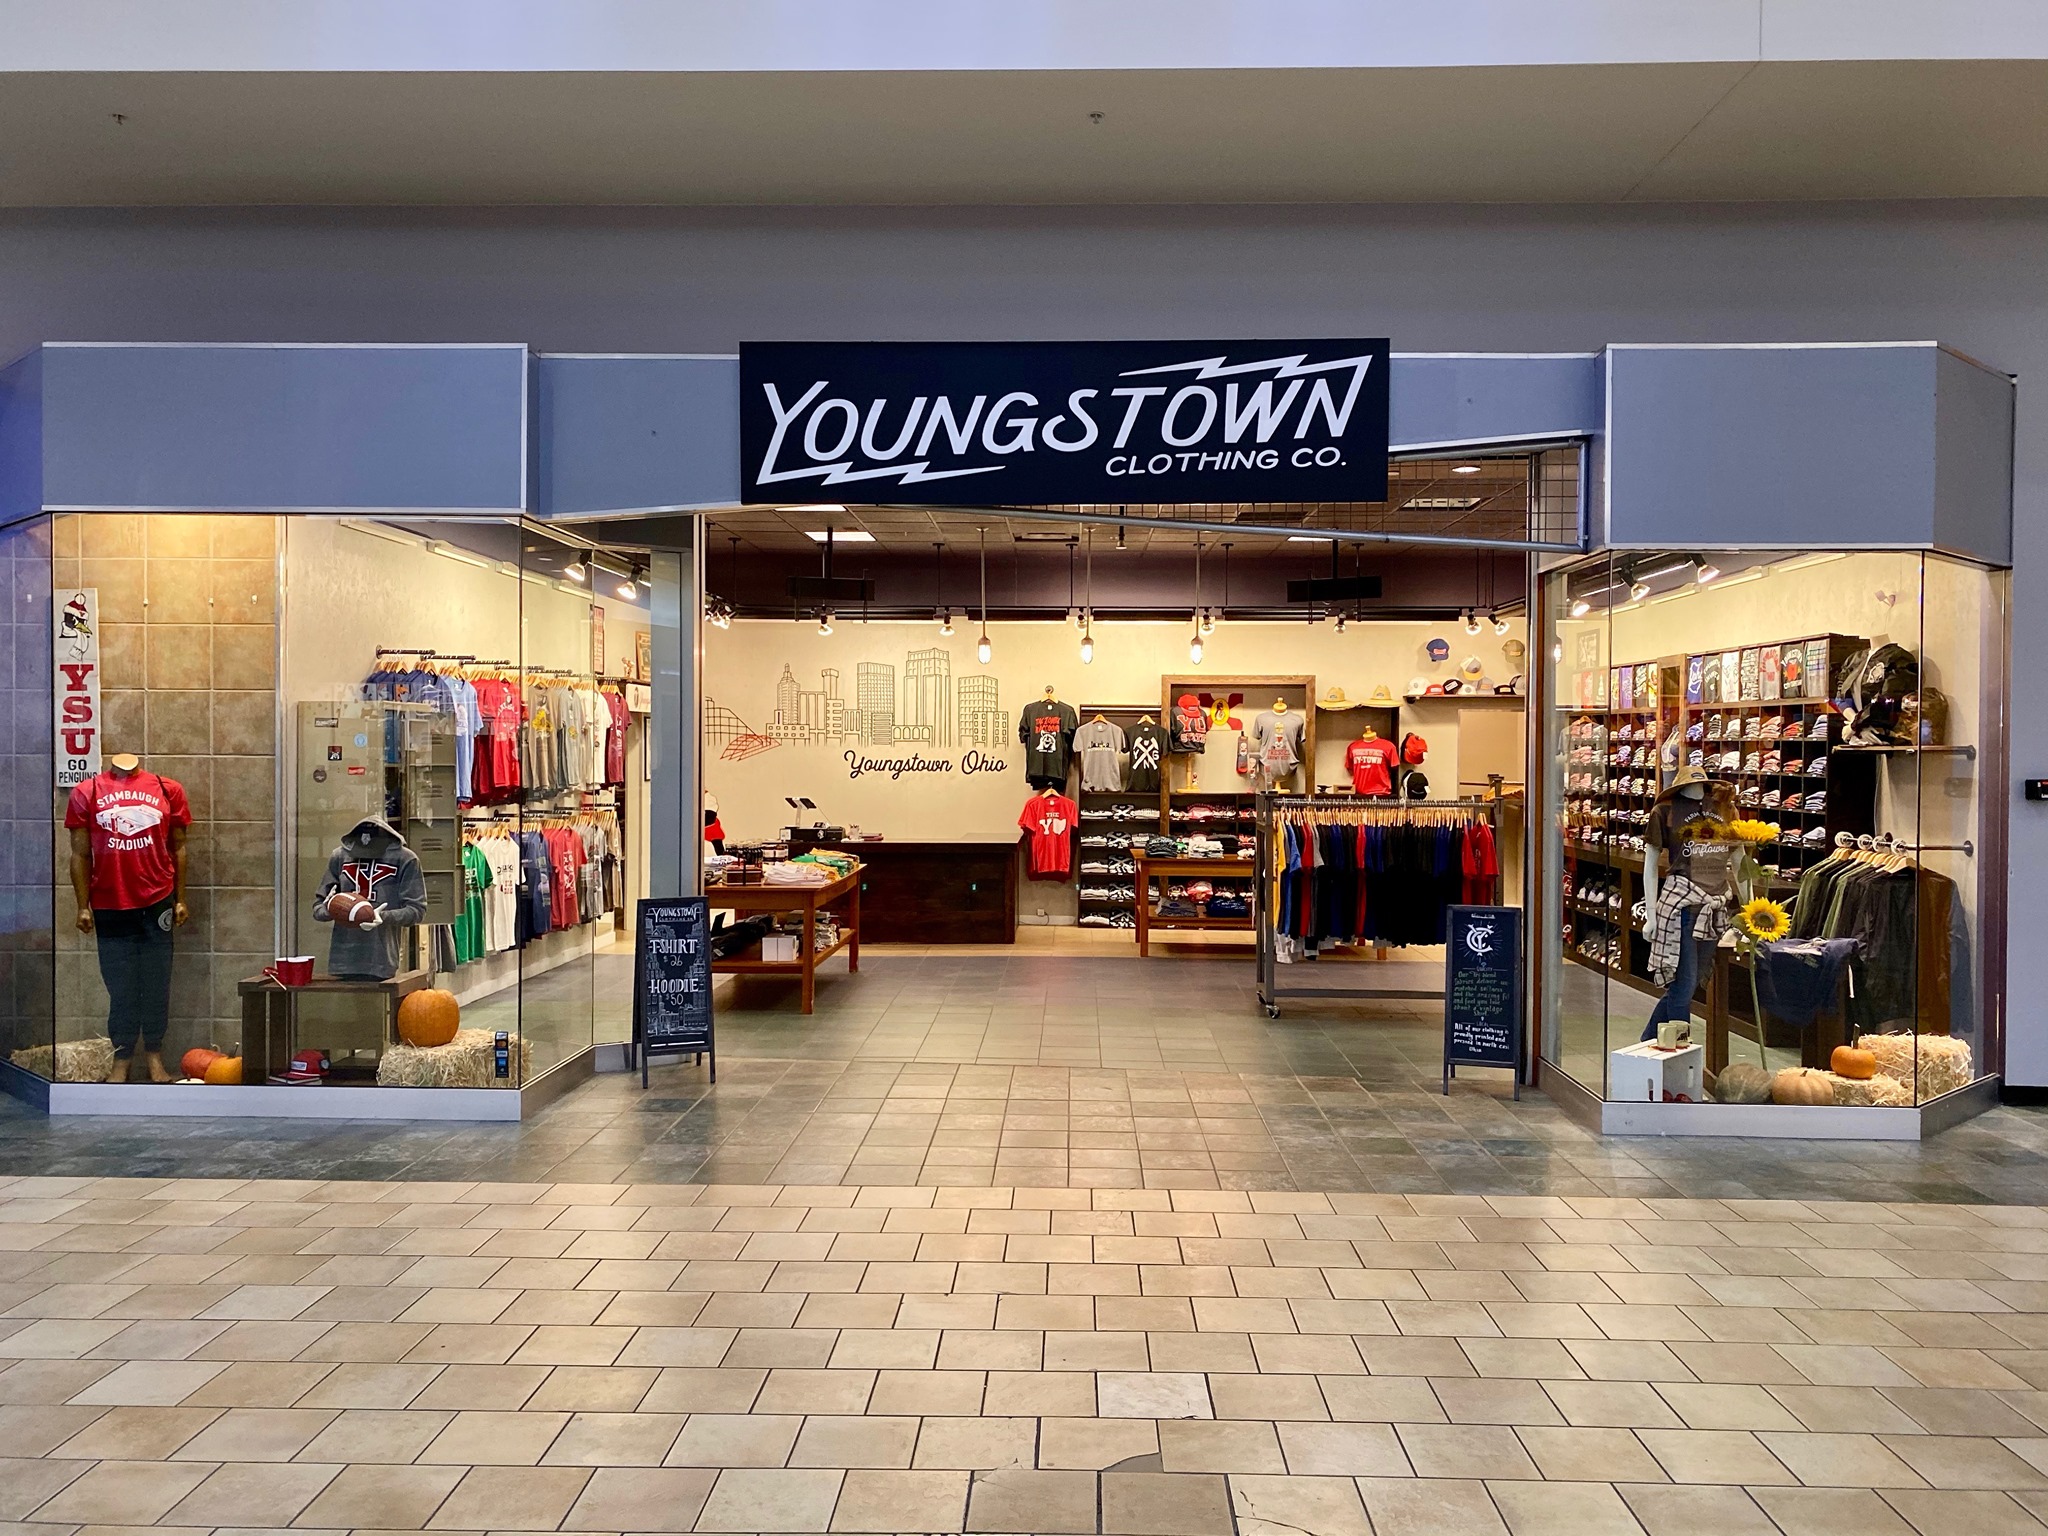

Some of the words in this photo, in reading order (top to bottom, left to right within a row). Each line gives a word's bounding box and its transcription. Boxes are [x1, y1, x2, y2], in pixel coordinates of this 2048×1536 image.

[757, 357, 1373, 480] YOUNGSTOWN
[1105, 450, 1284, 477] CLOTHING
[1290, 446, 1347, 468] CO.
[60, 664, 95, 756] YSU
[68, 759, 87, 770] GO
[843, 750, 952, 780] Youngstown
[961, 750, 1007, 775] Ohio
[97, 790, 160, 809] STAMBAUGH
[107, 835, 154, 850] STADIUM
[650, 978, 699, 994] HOODIE
[1454, 1022, 1464, 1031] All
